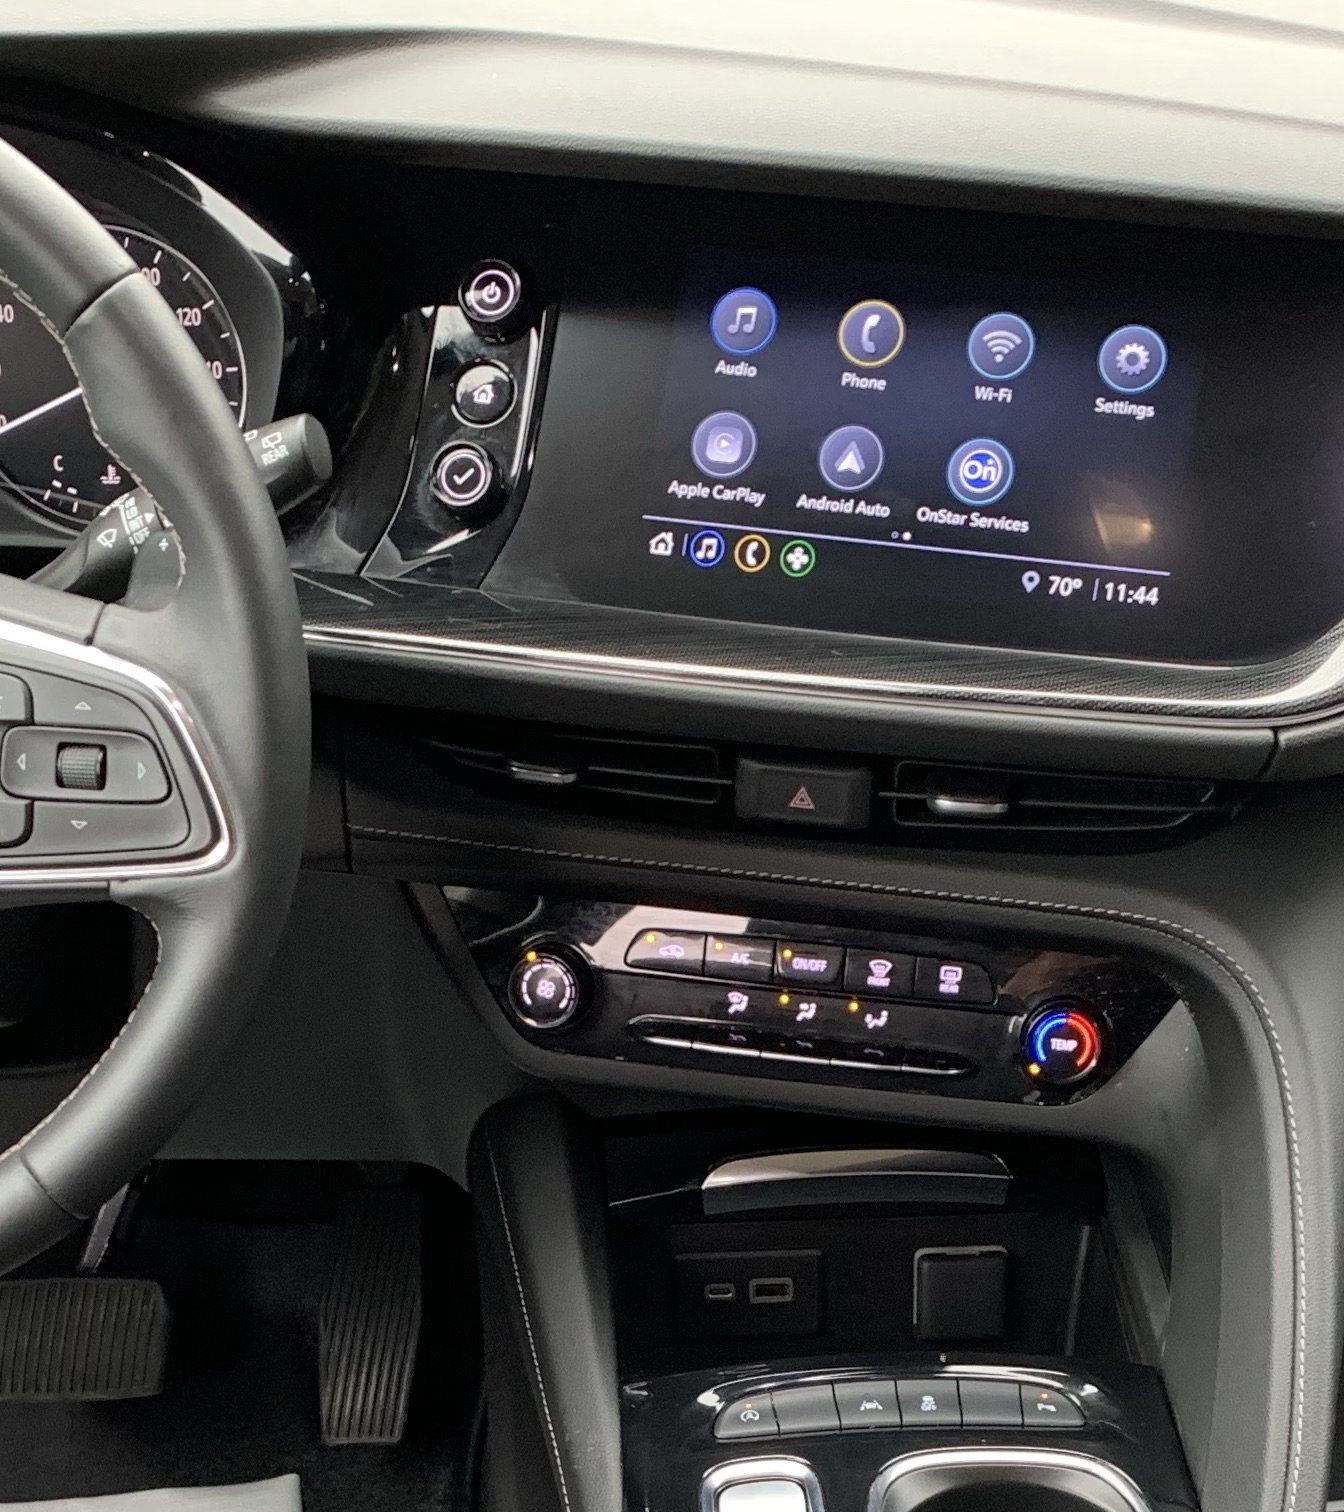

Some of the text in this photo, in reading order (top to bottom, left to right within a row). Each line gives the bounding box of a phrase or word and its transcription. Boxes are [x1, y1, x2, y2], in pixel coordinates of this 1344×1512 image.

[176, 307, 201, 326] 120
[714, 360, 757, 378] Audio
[841, 372, 887, 391] Phone
[974, 385, 1013, 403] Wi-Fi
[1094, 397, 1155, 421] Settings
[53, 455, 64, 472] C
[261, 446, 289, 466] REAR
[667, 480, 766, 507] Apple CarPlay
[796, 494, 891, 519] Android Auto
[916, 507, 1030, 533] OnStar Services
[1104, 582, 1160, 606] 11:44
[792, 957, 827, 972] ON/OFF
[1050, 1038, 1077, 1051] TEMP
